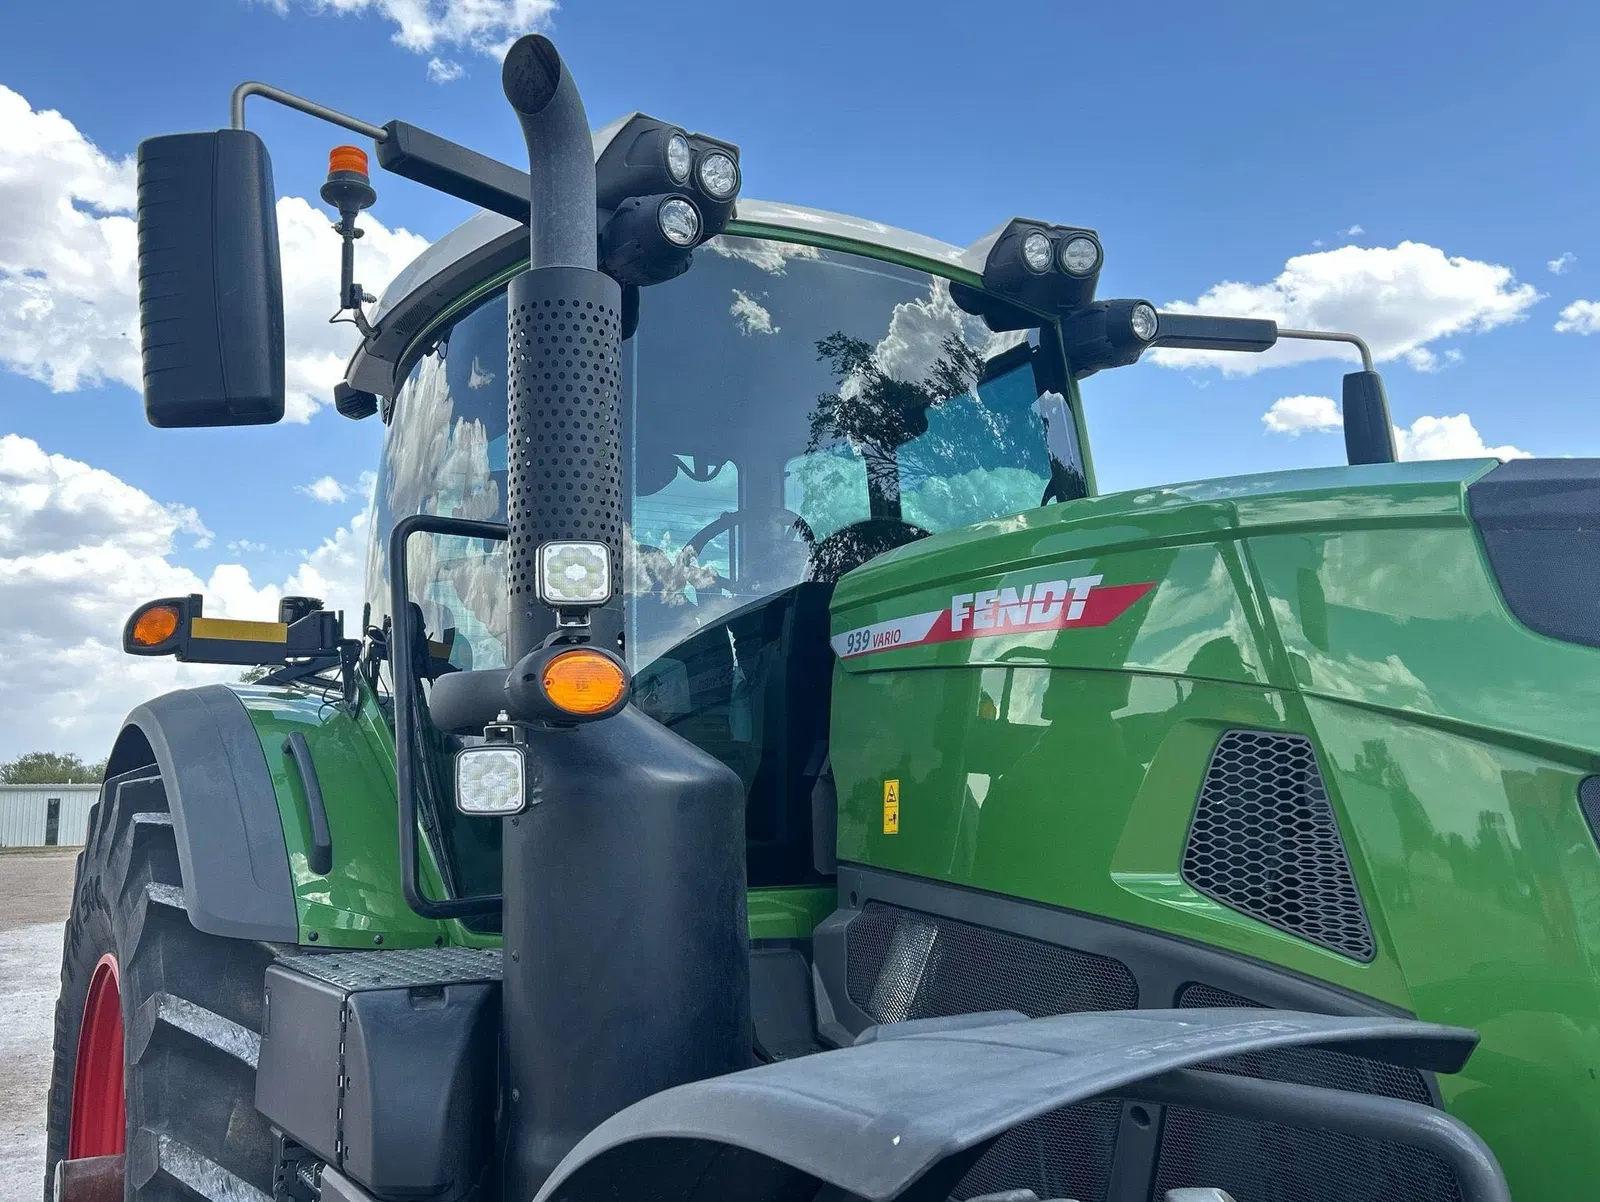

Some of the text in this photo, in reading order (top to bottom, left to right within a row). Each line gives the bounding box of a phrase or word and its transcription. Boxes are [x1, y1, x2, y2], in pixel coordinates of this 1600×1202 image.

[951, 574, 1104, 632] FENDT
[847, 629, 901, 655] 939 VARIO
